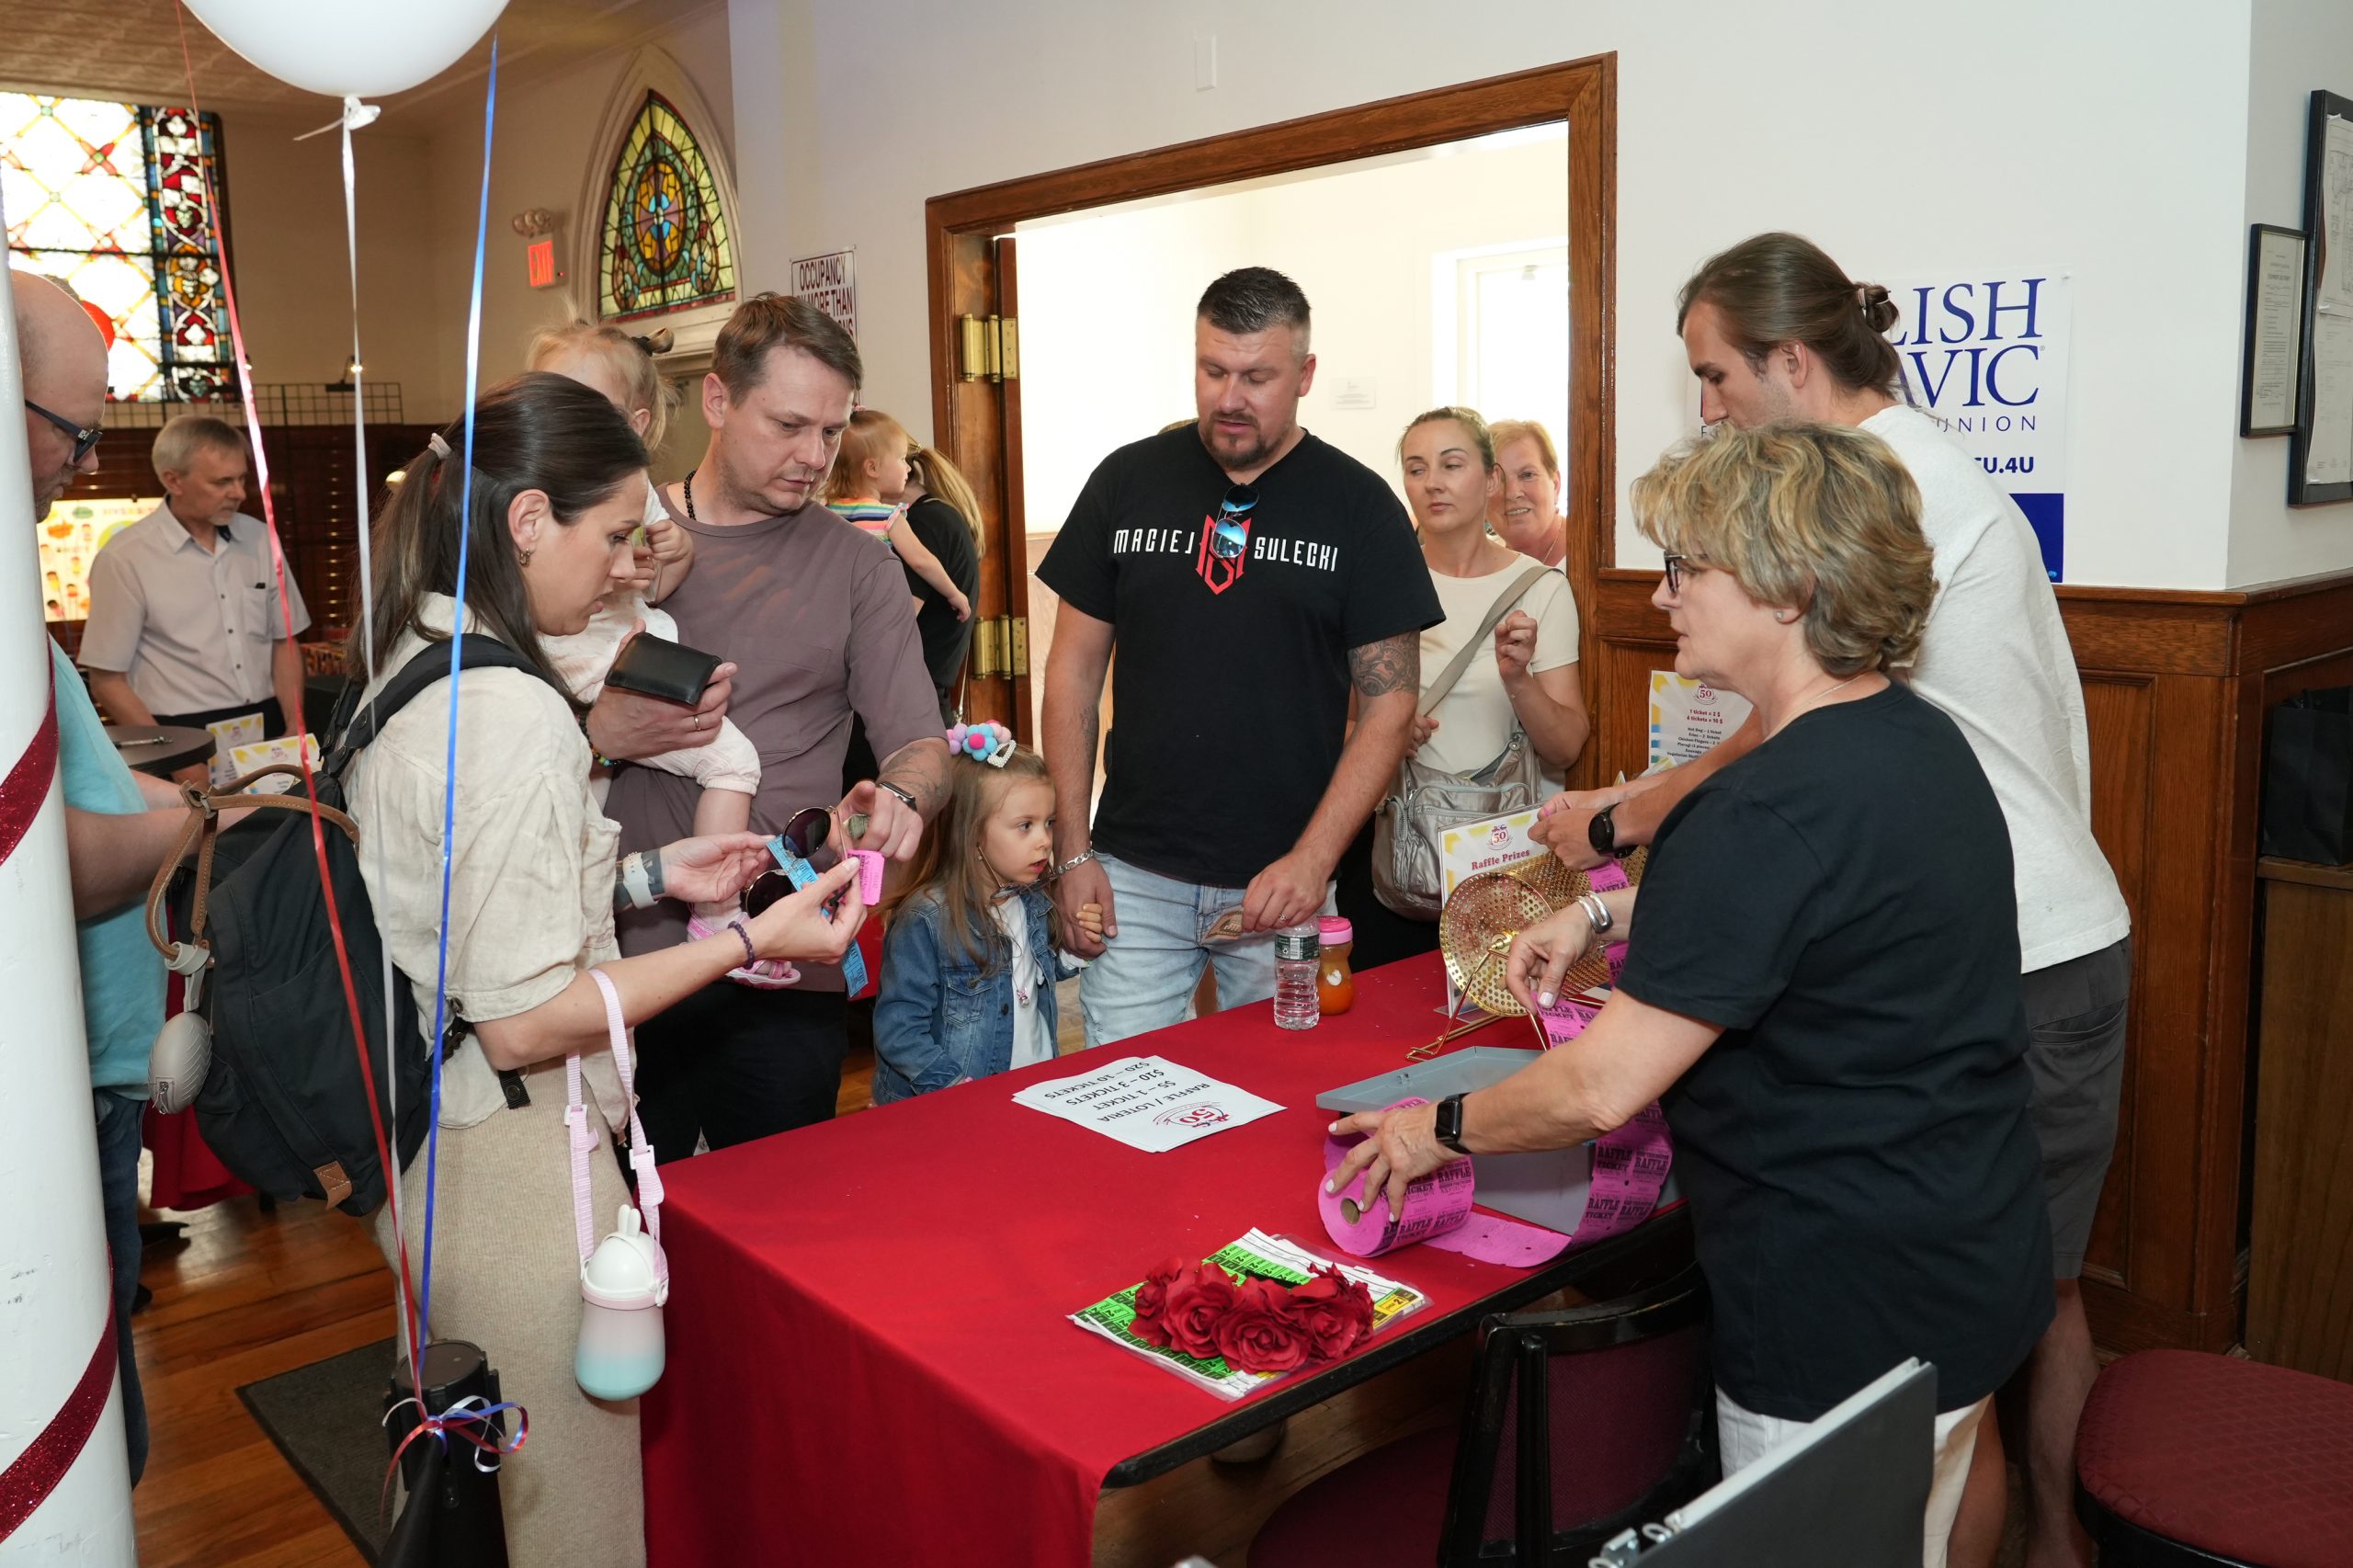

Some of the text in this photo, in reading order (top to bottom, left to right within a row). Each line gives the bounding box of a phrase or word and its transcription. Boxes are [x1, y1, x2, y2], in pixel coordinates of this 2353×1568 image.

[799, 256, 846, 291] OCCUPANCY
[831, 287, 853, 316] THAN
[1973, 456, 2034, 474] U.4U
[1113, 528, 1195, 554] MACIEJ
[1699, 689, 1712, 699] 50
[1493, 831, 1506, 844] 50
[1471, 849, 1530, 871] Raffle Prizes
[1124, 1062, 1150, 1072] $20
[1138, 1069, 1165, 1081] $10
[1044, 1081, 1099, 1099] TICKETS
[1157, 1080, 1176, 1088] $5
[1163, 1083, 1211, 1101] RAFFLE
[1065, 1085, 1120, 1106] TICKETS
[1093, 1094, 1140, 1110] TICKET
[1097, 1102, 1156, 1122] LOTERIA
[1179, 1108, 1215, 1124] 50
[1597, 1146, 1633, 1162] RAFFLE
[1634, 1157, 1668, 1171] RAFFLE
[1438, 1165, 1472, 1183] RAFFLE
[1406, 1182, 1434, 1195] ICKET
[1586, 1198, 1620, 1210] RAFFLE
[1399, 1218, 1433, 1234] RAFFLE
[1434, 1213, 1465, 1229] RAFFLE
